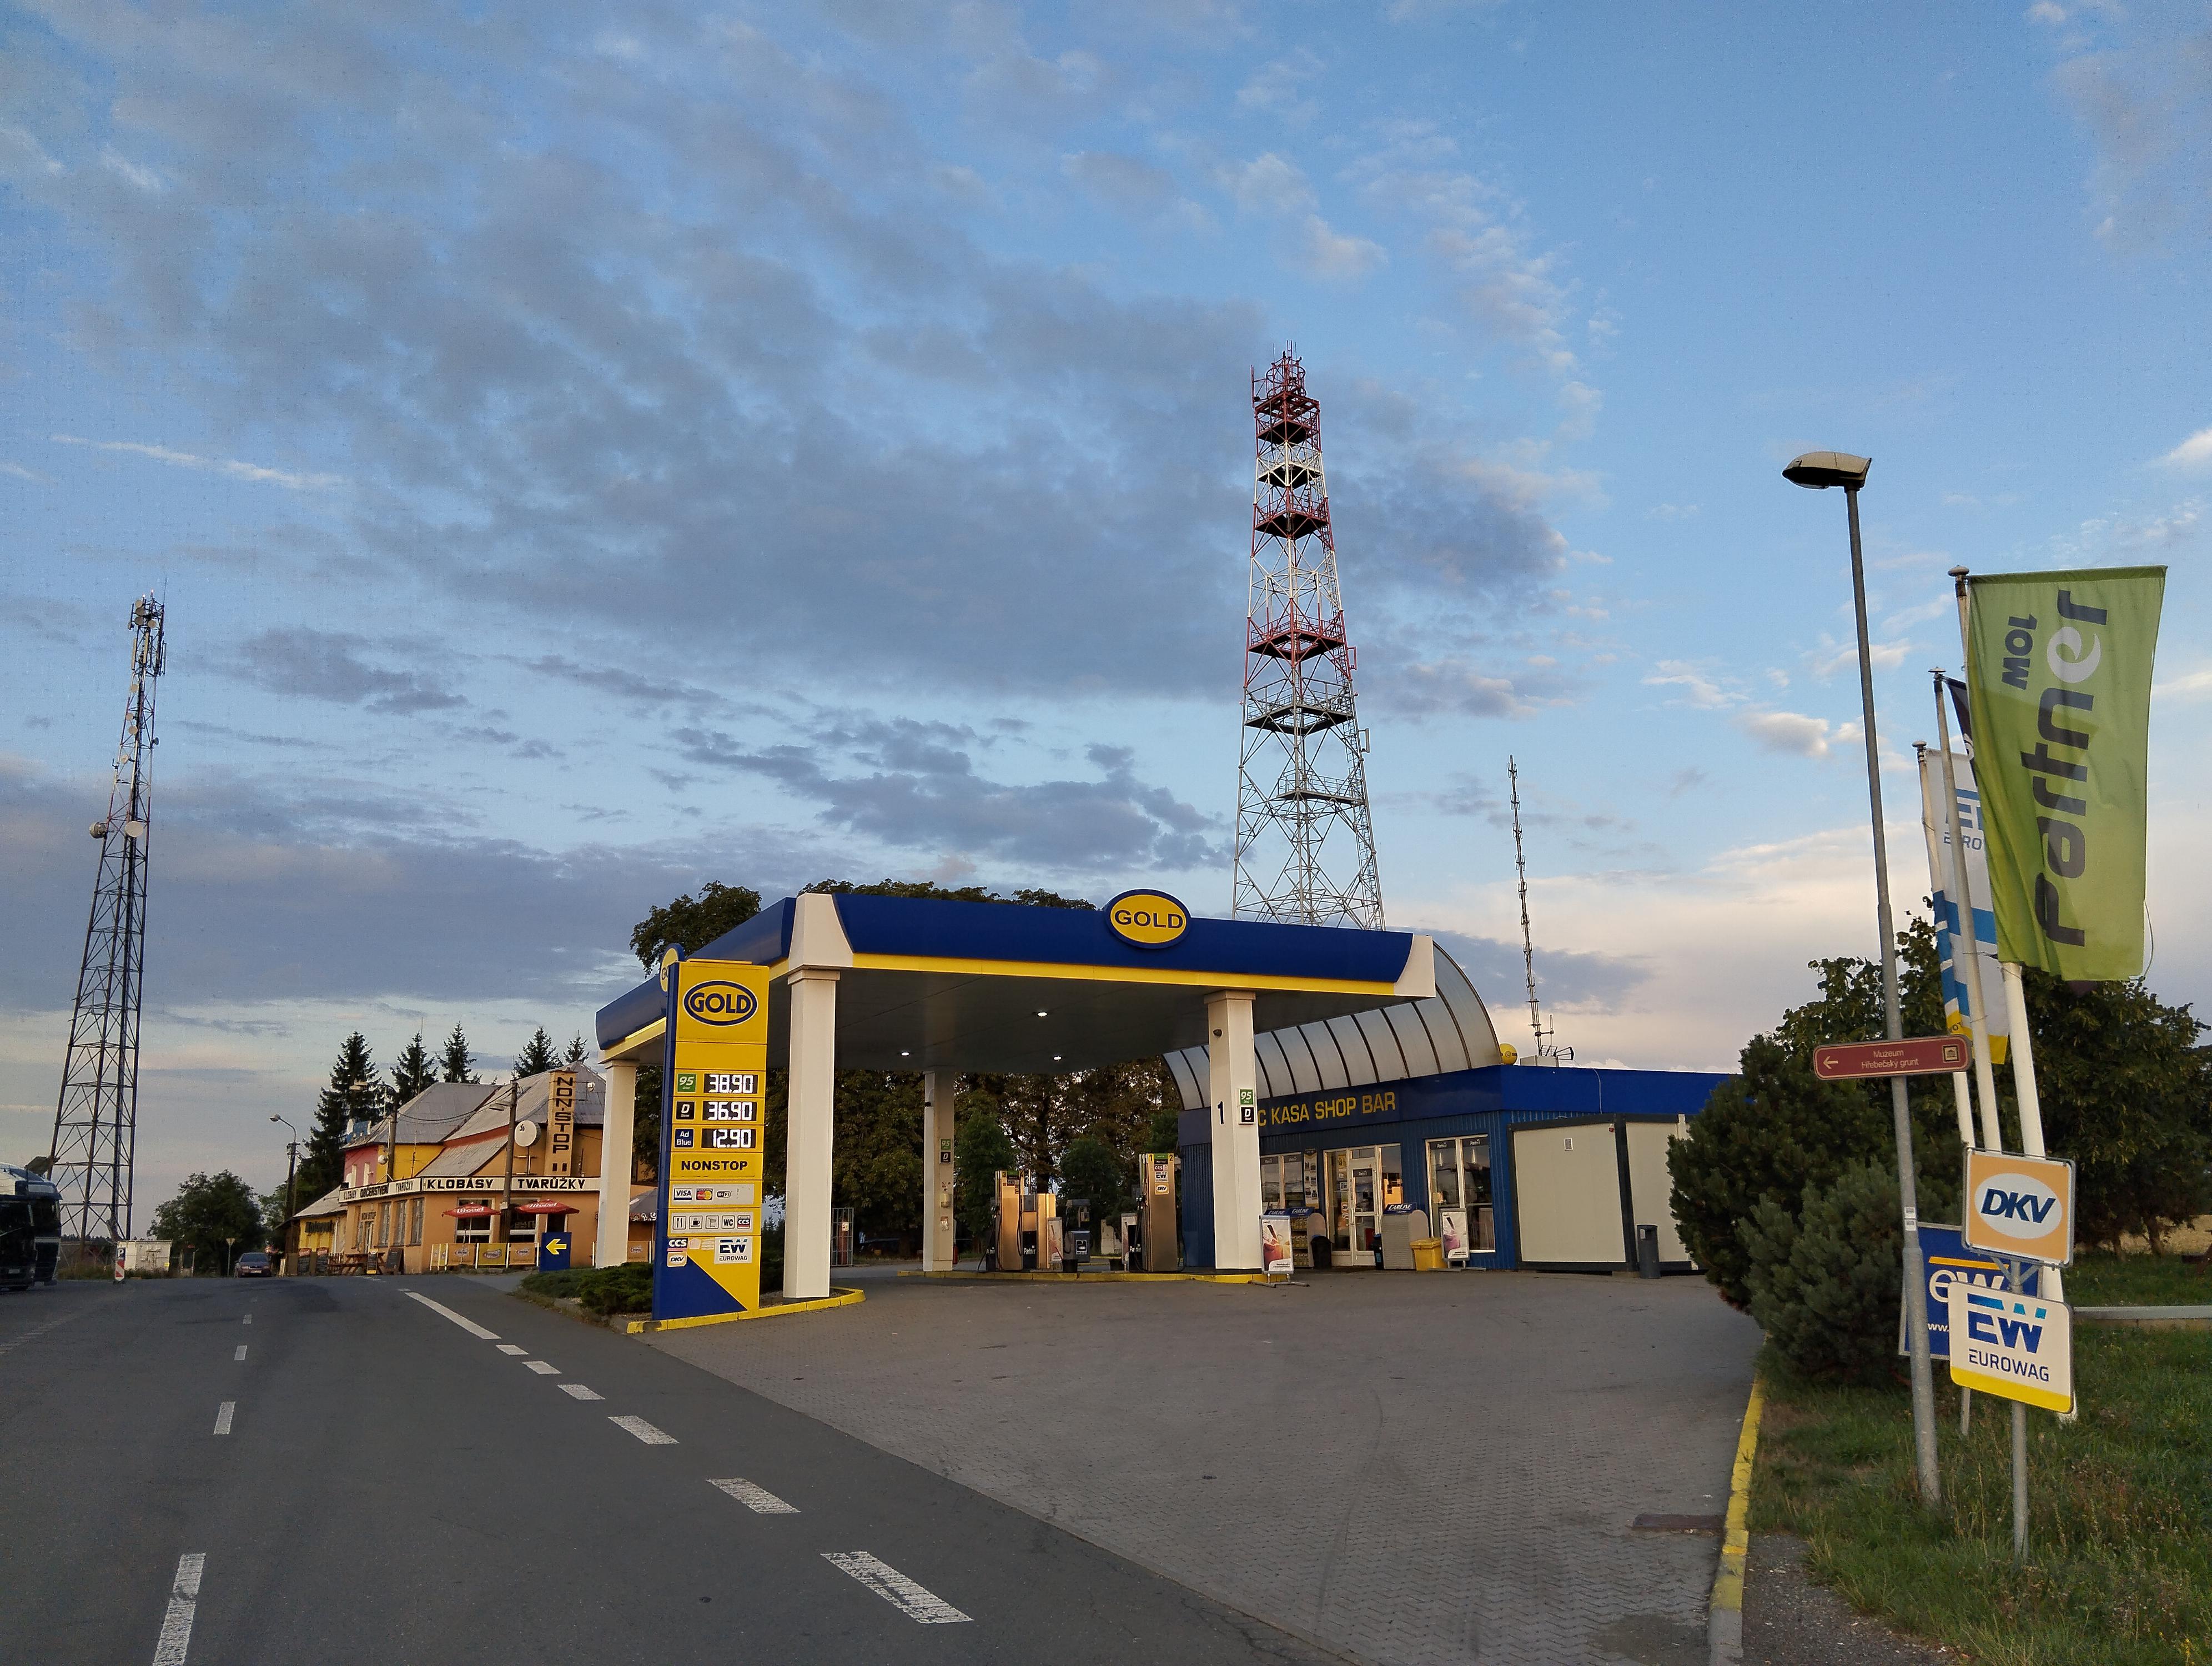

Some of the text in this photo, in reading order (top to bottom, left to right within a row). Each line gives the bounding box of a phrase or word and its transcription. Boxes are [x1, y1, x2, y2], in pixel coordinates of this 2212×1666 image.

[2002, 614, 2038, 690] MOL
[2021, 589, 2108, 947] Partner
[1114, 910, 1184, 929] GOLD
[690, 992, 751, 1013] GOLD
[1900, 1058, 1919, 1068] grunt
[679, 1075, 753, 1093] 95 38.90
[1241, 1091, 1252, 1100] 95
[681, 1102, 753, 1121] D 36.90
[1217, 1101, 1224, 1125] 1
[1244, 1108, 1251, 1117] D
[1271, 1103, 1310, 1125] KASA
[1315, 1096, 1357, 1120] SHOP
[1362, 1091, 1396, 1115] BAR
[713, 1129, 752, 1148] 12.90
[681, 1161, 748, 1172] NONSTOP
[427, 1176, 586, 1190] KLOBÁSY TVARŮŽKY
[1980, 1187, 2056, 1223] DKV
[1968, 1293, 2047, 1354] EW
[1969, 1349, 2050, 1384] EUROWAG
